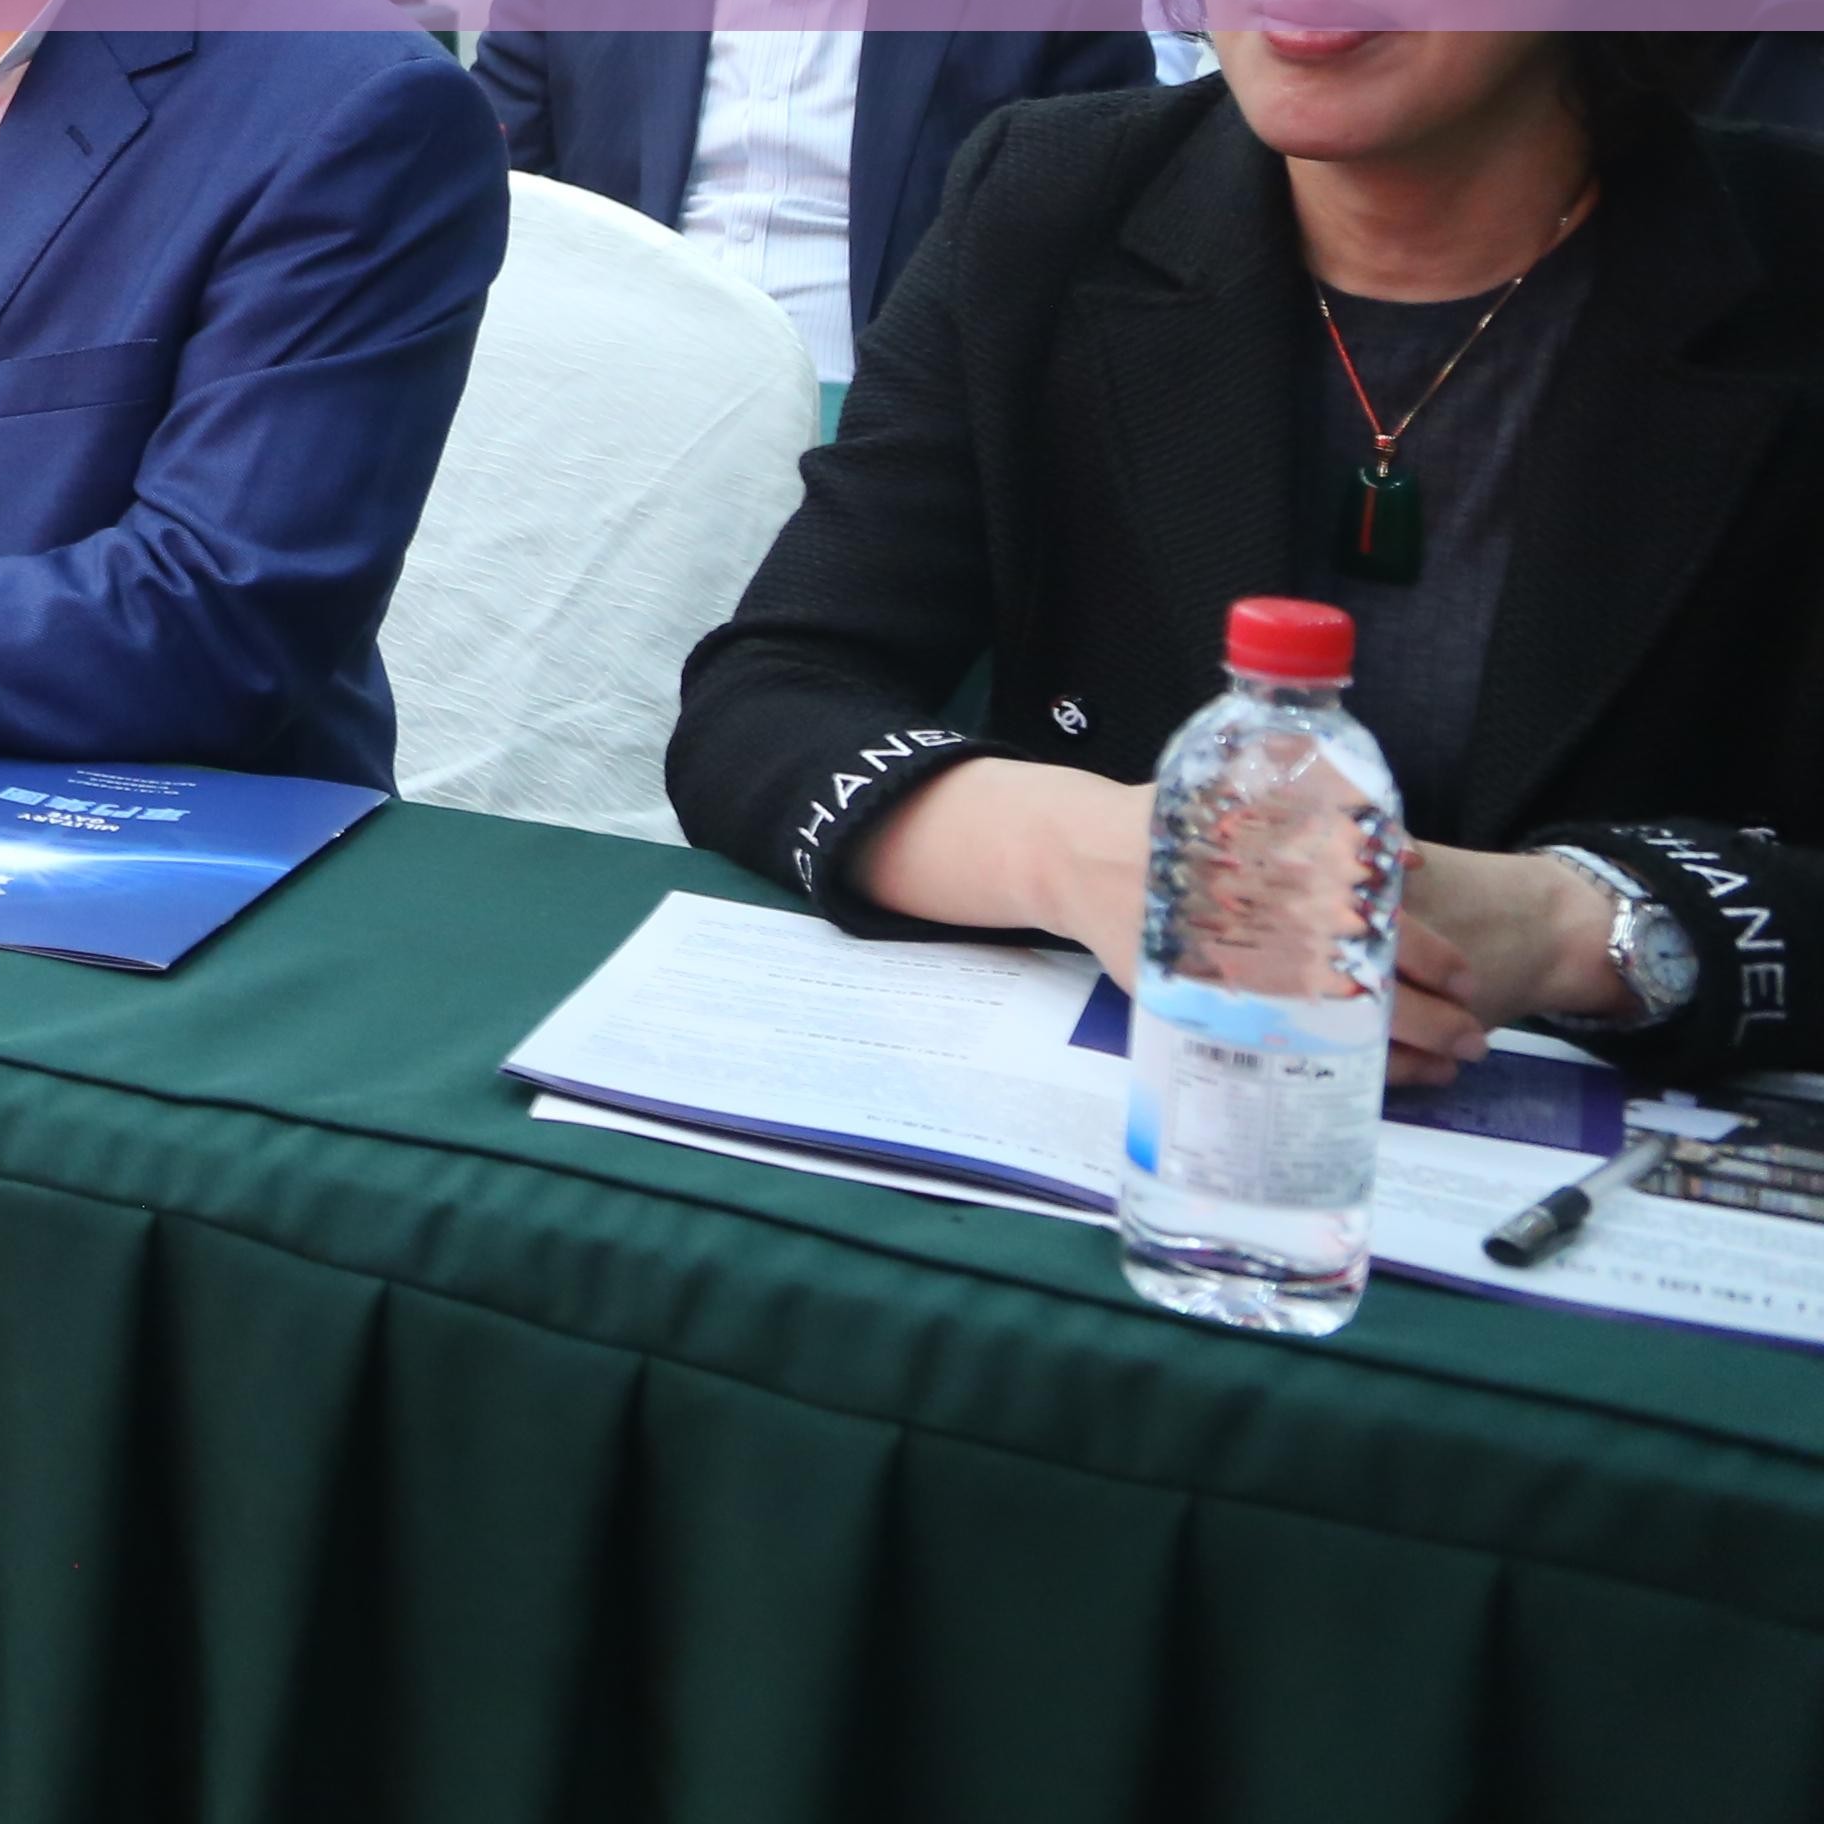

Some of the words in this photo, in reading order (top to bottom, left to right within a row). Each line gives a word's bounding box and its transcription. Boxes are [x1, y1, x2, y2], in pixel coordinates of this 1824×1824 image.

[16, 811, 121, 833] MILITARY
[792, 729, 968, 893] CHANE
[1610, 826, 1788, 1047] HANEL
